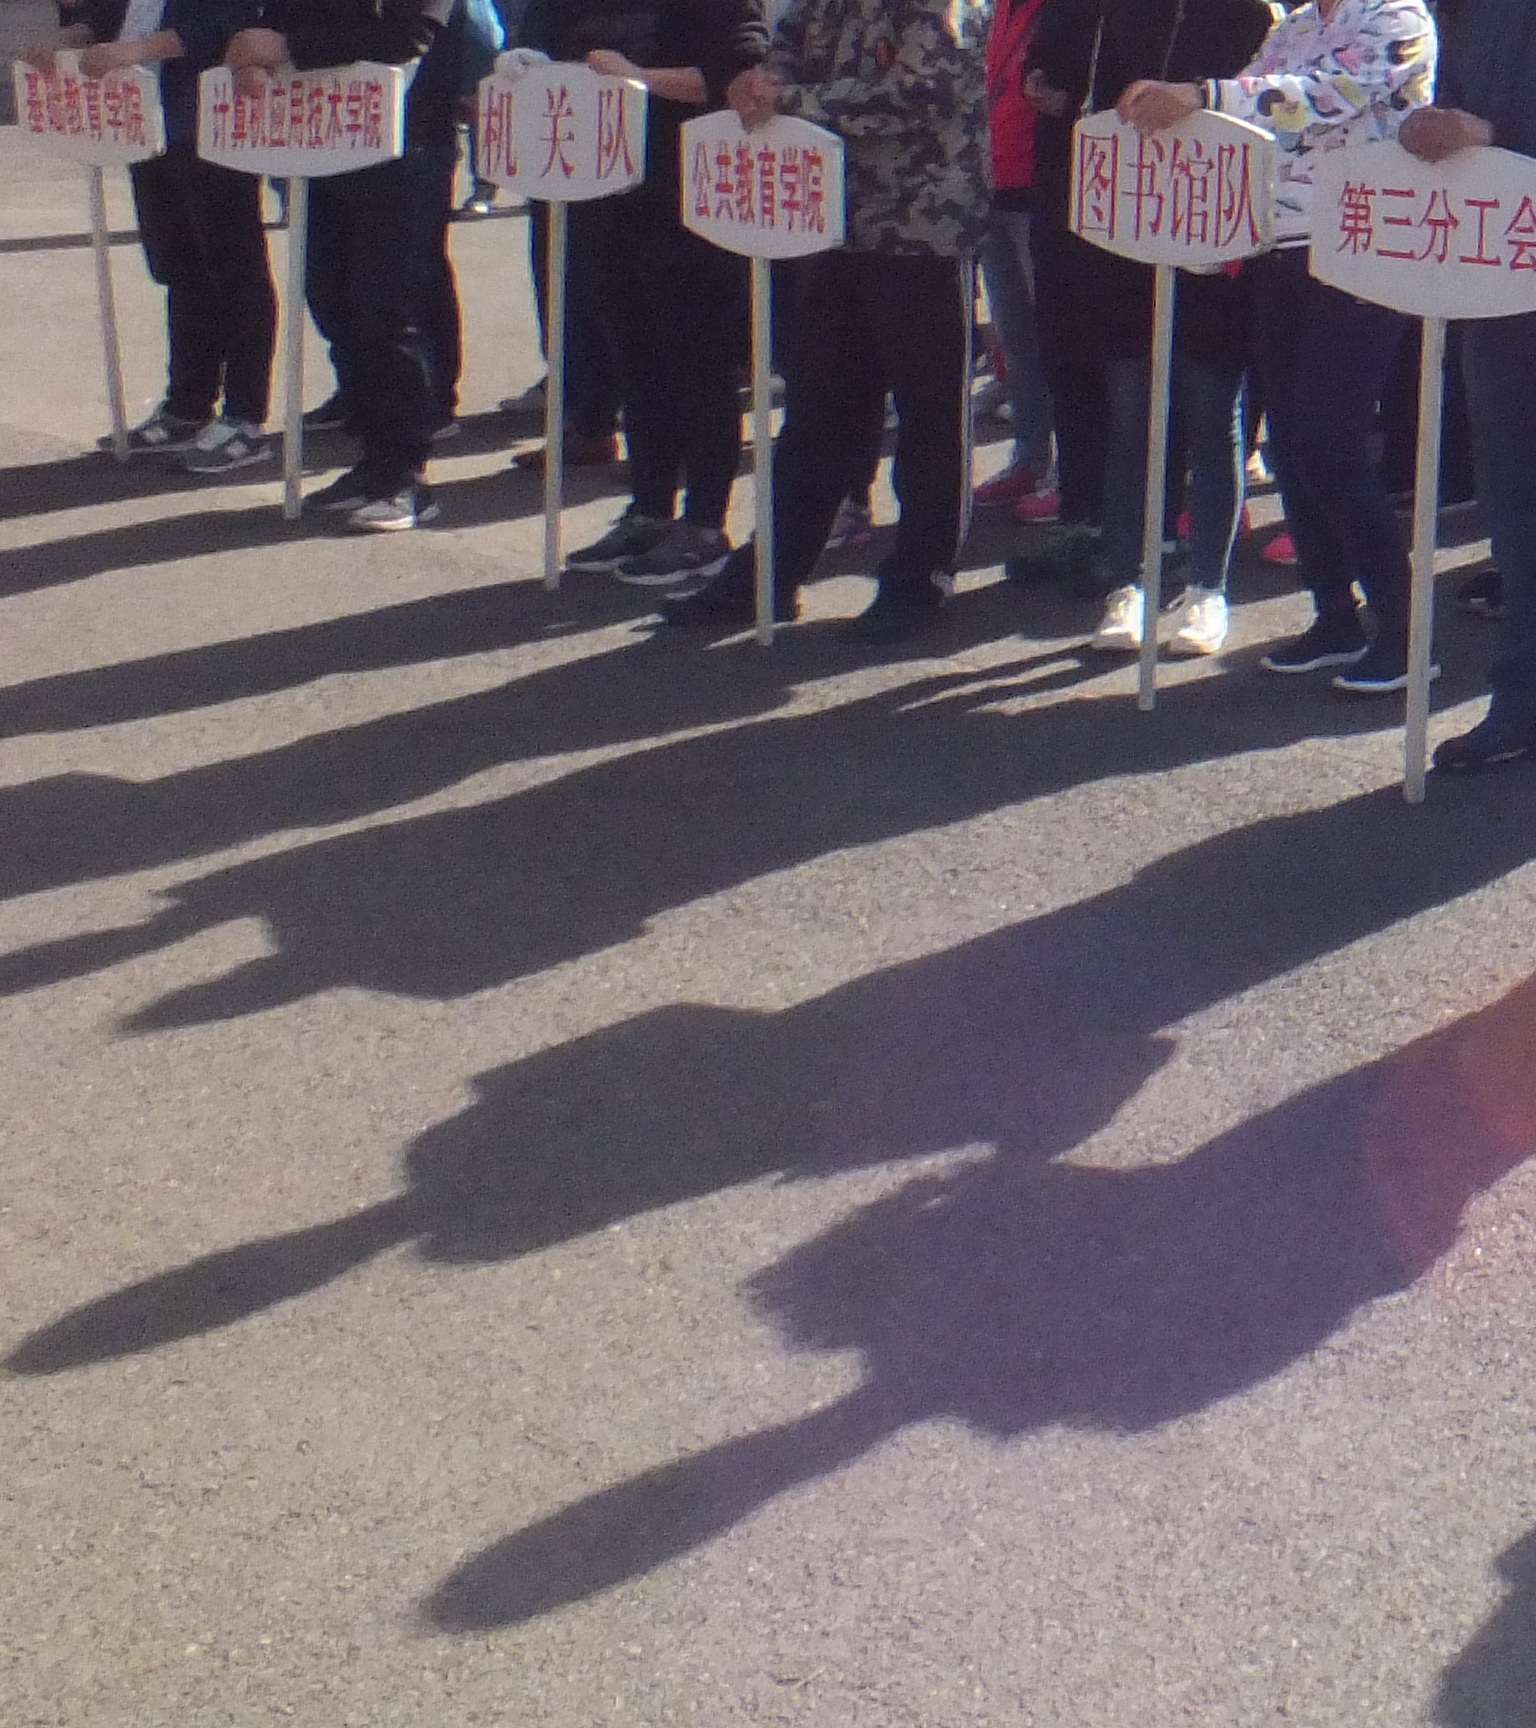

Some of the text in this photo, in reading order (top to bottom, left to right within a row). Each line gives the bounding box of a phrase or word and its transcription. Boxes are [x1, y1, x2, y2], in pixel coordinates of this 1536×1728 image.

[483, 84, 634, 178] 机关队
[693, 139, 824, 233] 公共教育学院
[1077, 132, 1260, 246] 图书馆队
